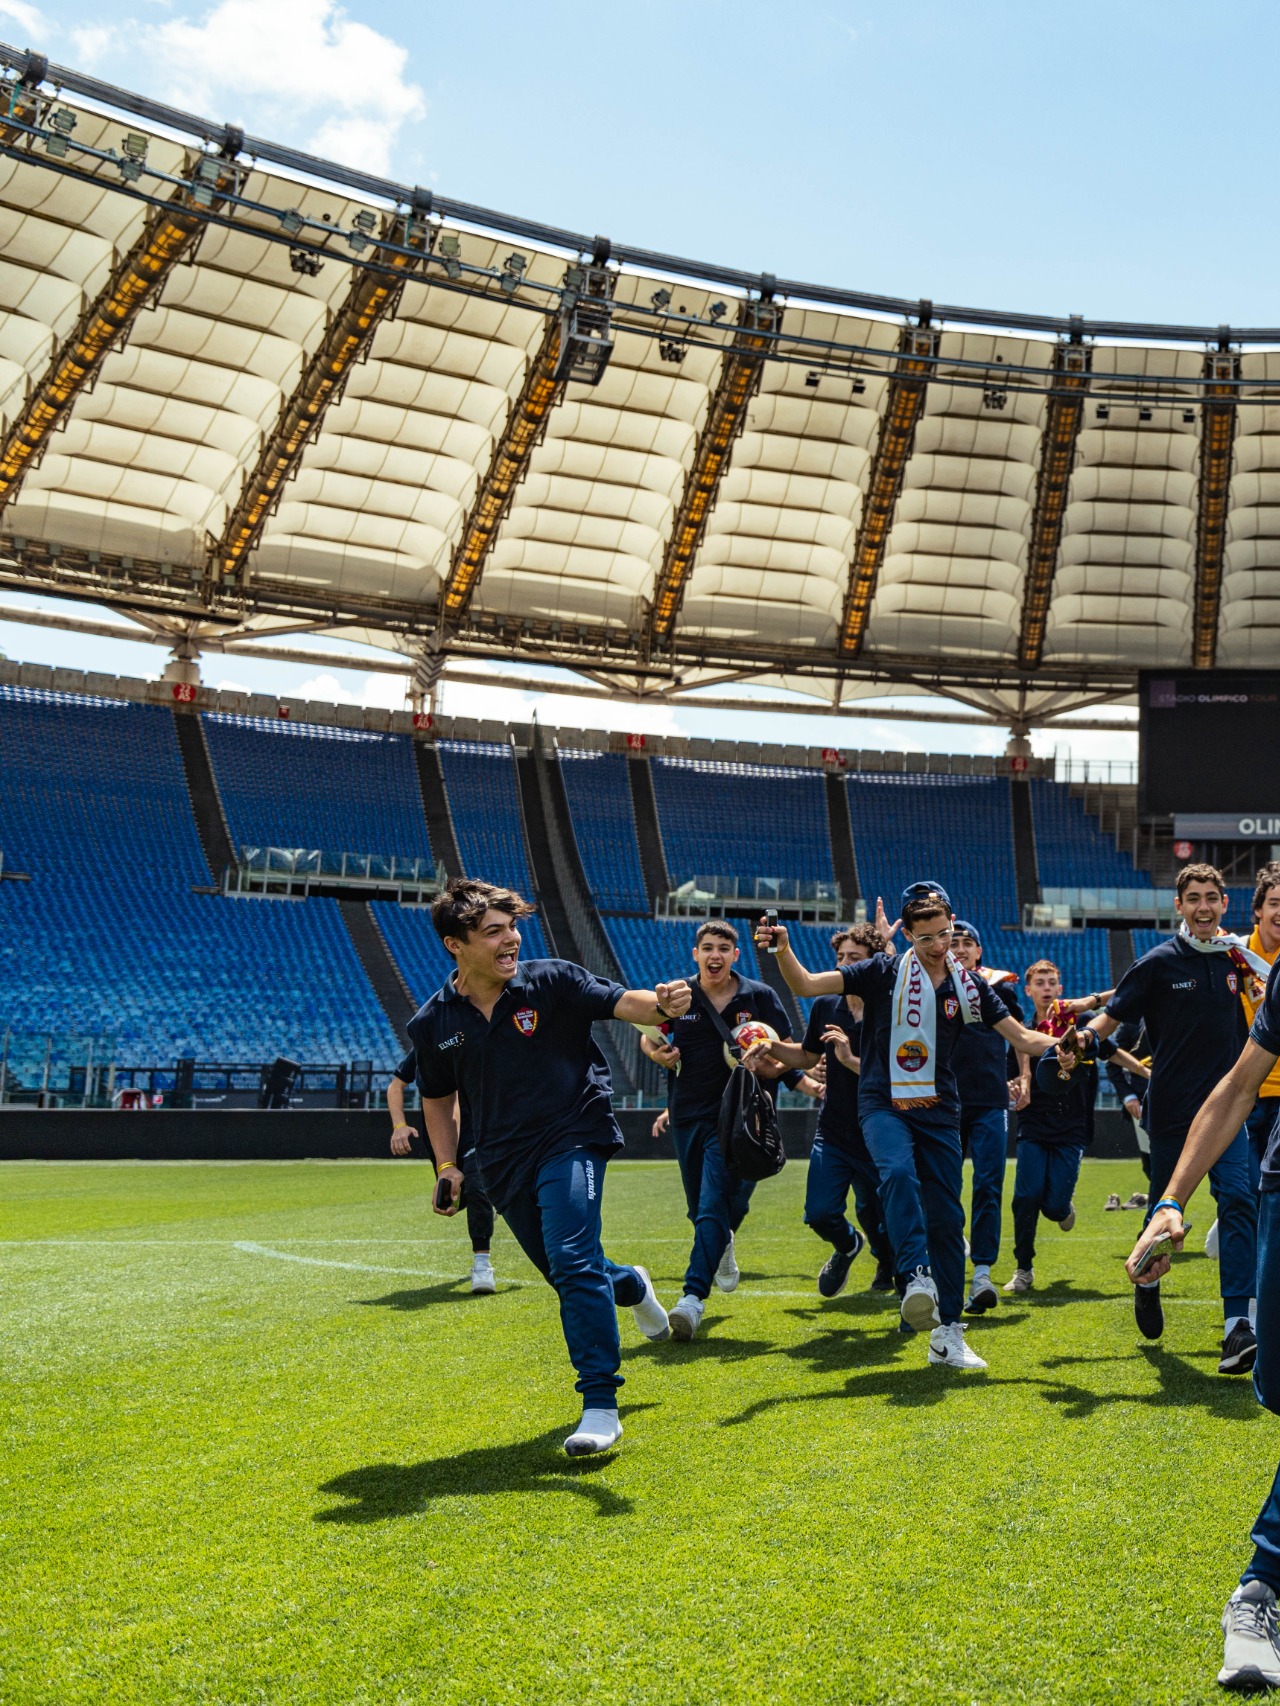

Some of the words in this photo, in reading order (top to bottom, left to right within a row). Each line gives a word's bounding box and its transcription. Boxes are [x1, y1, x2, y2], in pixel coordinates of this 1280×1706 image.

[1159, 694, 1197, 702] STADIO
[1198, 694, 1249, 703] OLIMPICO
[1172, 981, 1193, 990] ELNET
[438, 1035, 459, 1051] ELNET
[585, 1159, 597, 1201] sportika
